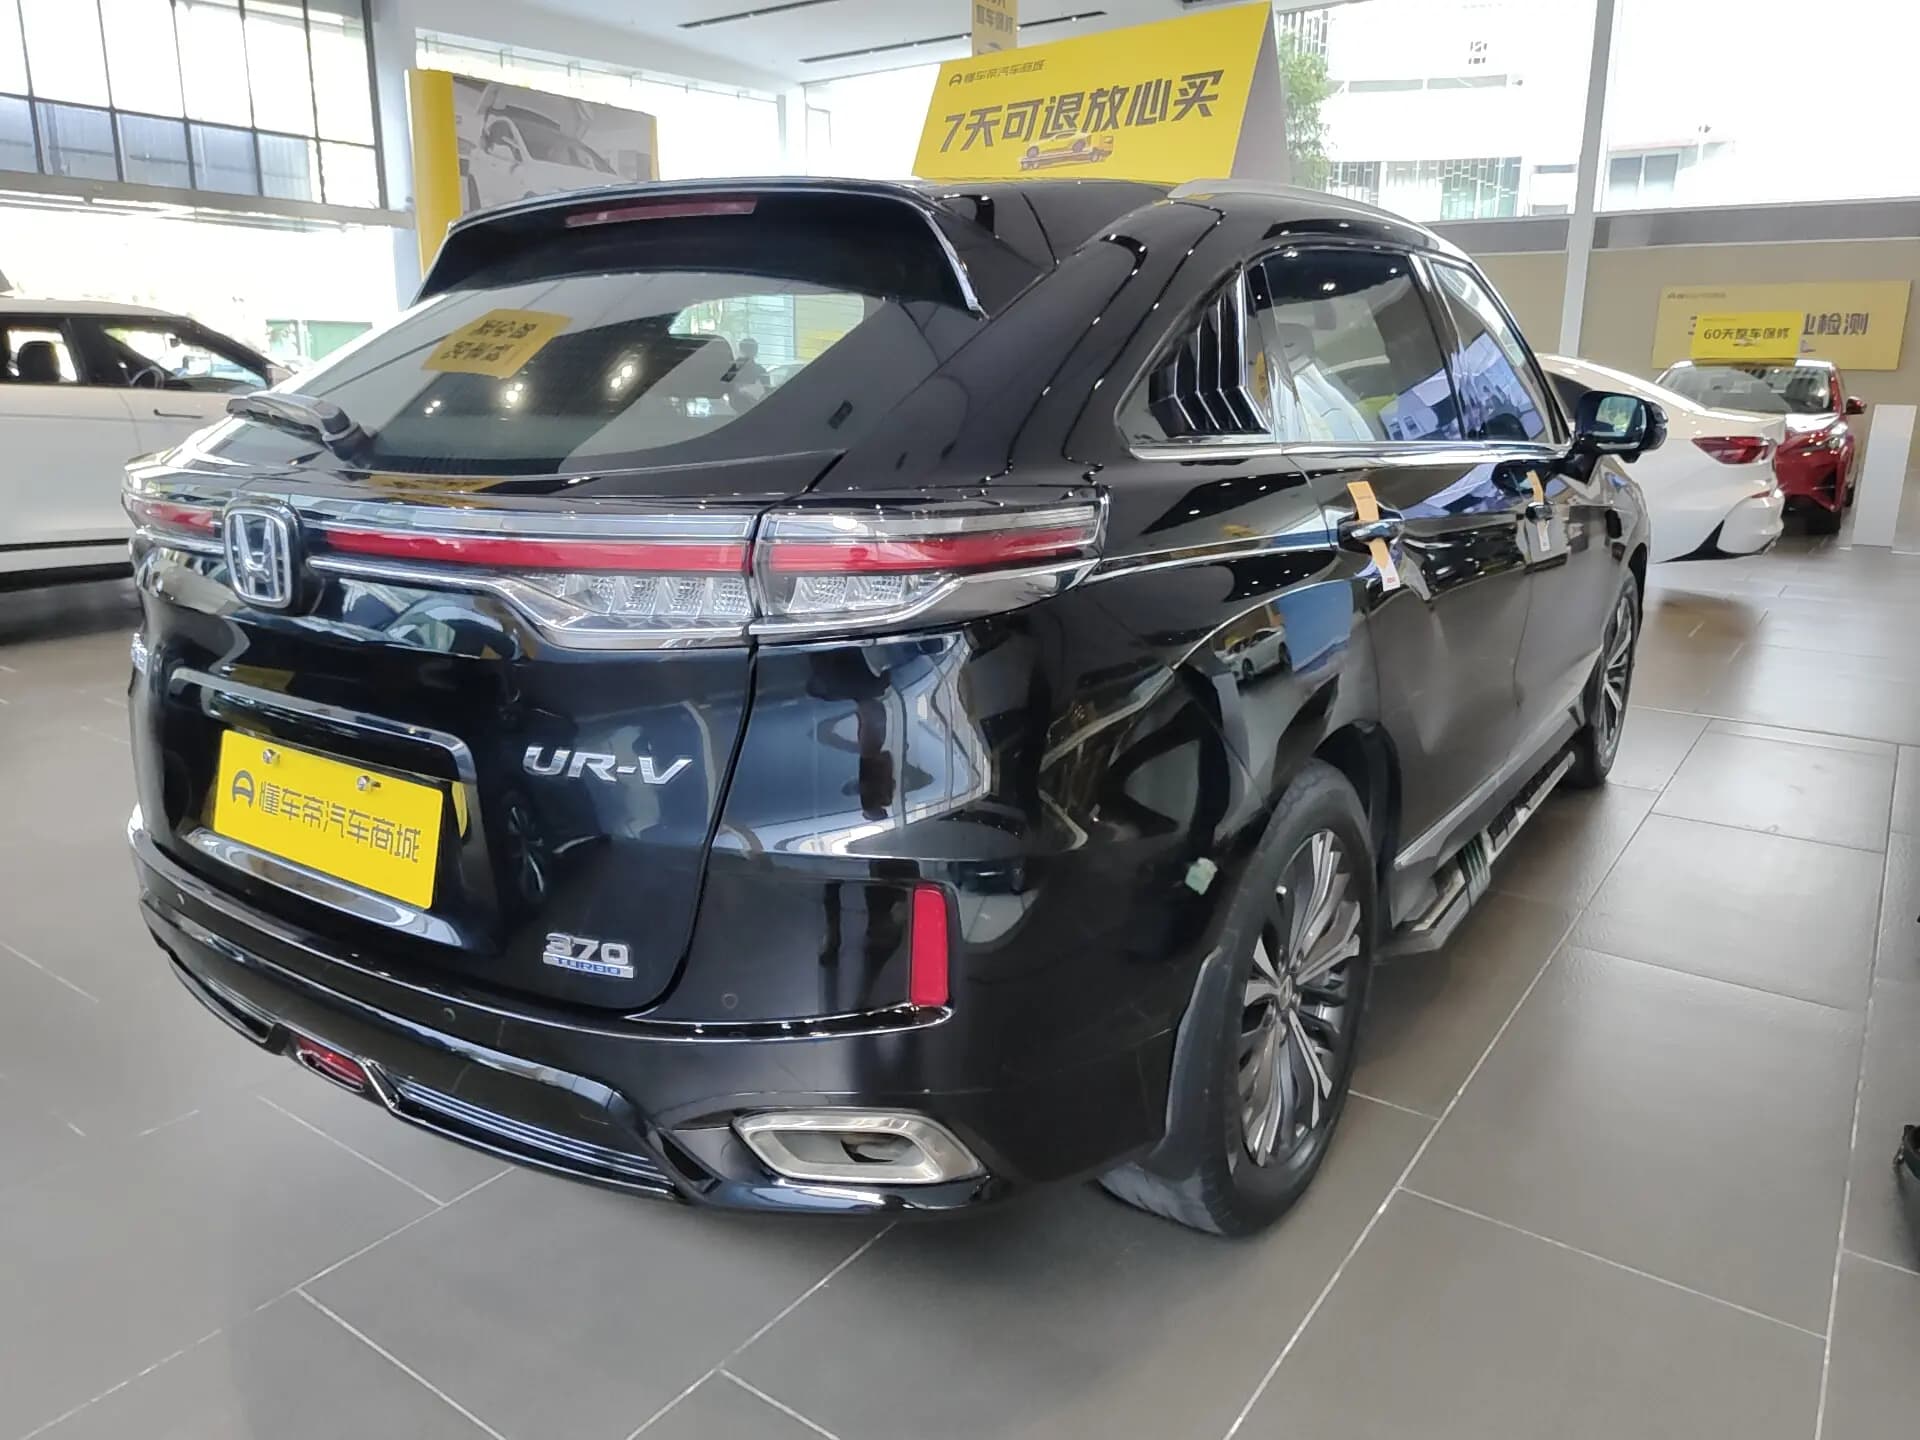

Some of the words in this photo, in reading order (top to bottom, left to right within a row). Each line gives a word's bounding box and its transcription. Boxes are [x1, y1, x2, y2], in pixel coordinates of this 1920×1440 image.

[940, 69, 1224, 153] 7天可退放心买
[522, 746, 693, 785] UR-V
[259, 781, 421, 863] 懂车帝汽车商城
[545, 932, 629, 965] 370
[553, 956, 622, 975] TURBO
